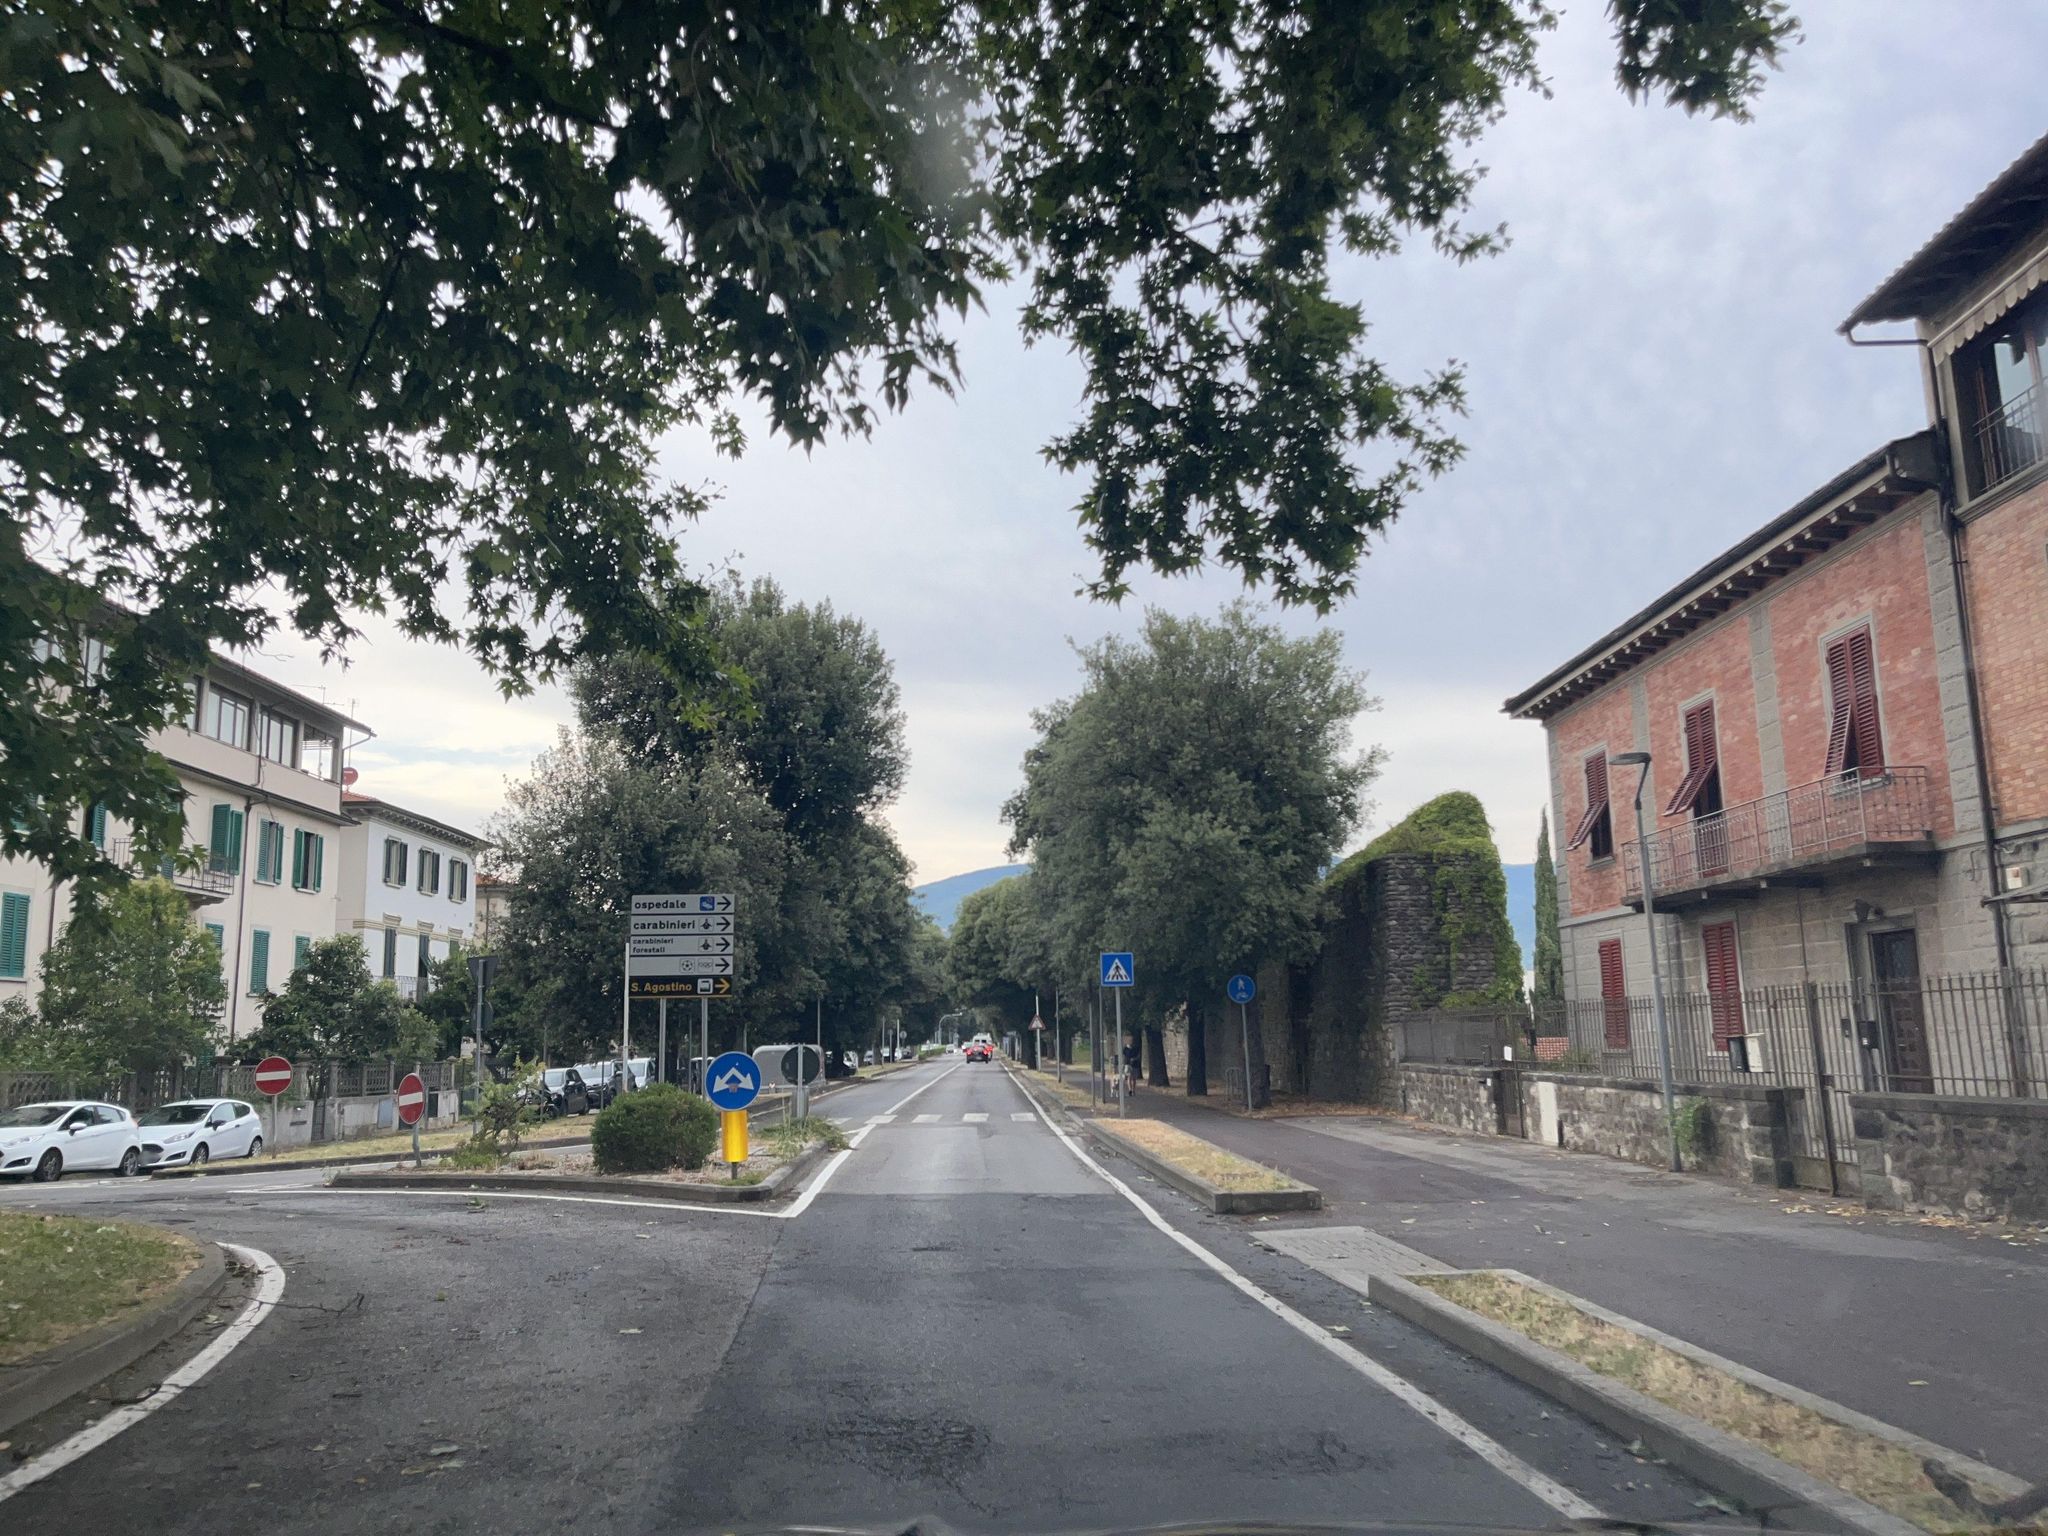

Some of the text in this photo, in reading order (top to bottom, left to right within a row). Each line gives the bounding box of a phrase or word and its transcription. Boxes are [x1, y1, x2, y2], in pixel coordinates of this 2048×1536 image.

[634, 899, 687, 911] ospedale
[633, 920, 695, 930] carabinieri
[630, 982, 692, 993] S. Agostino
